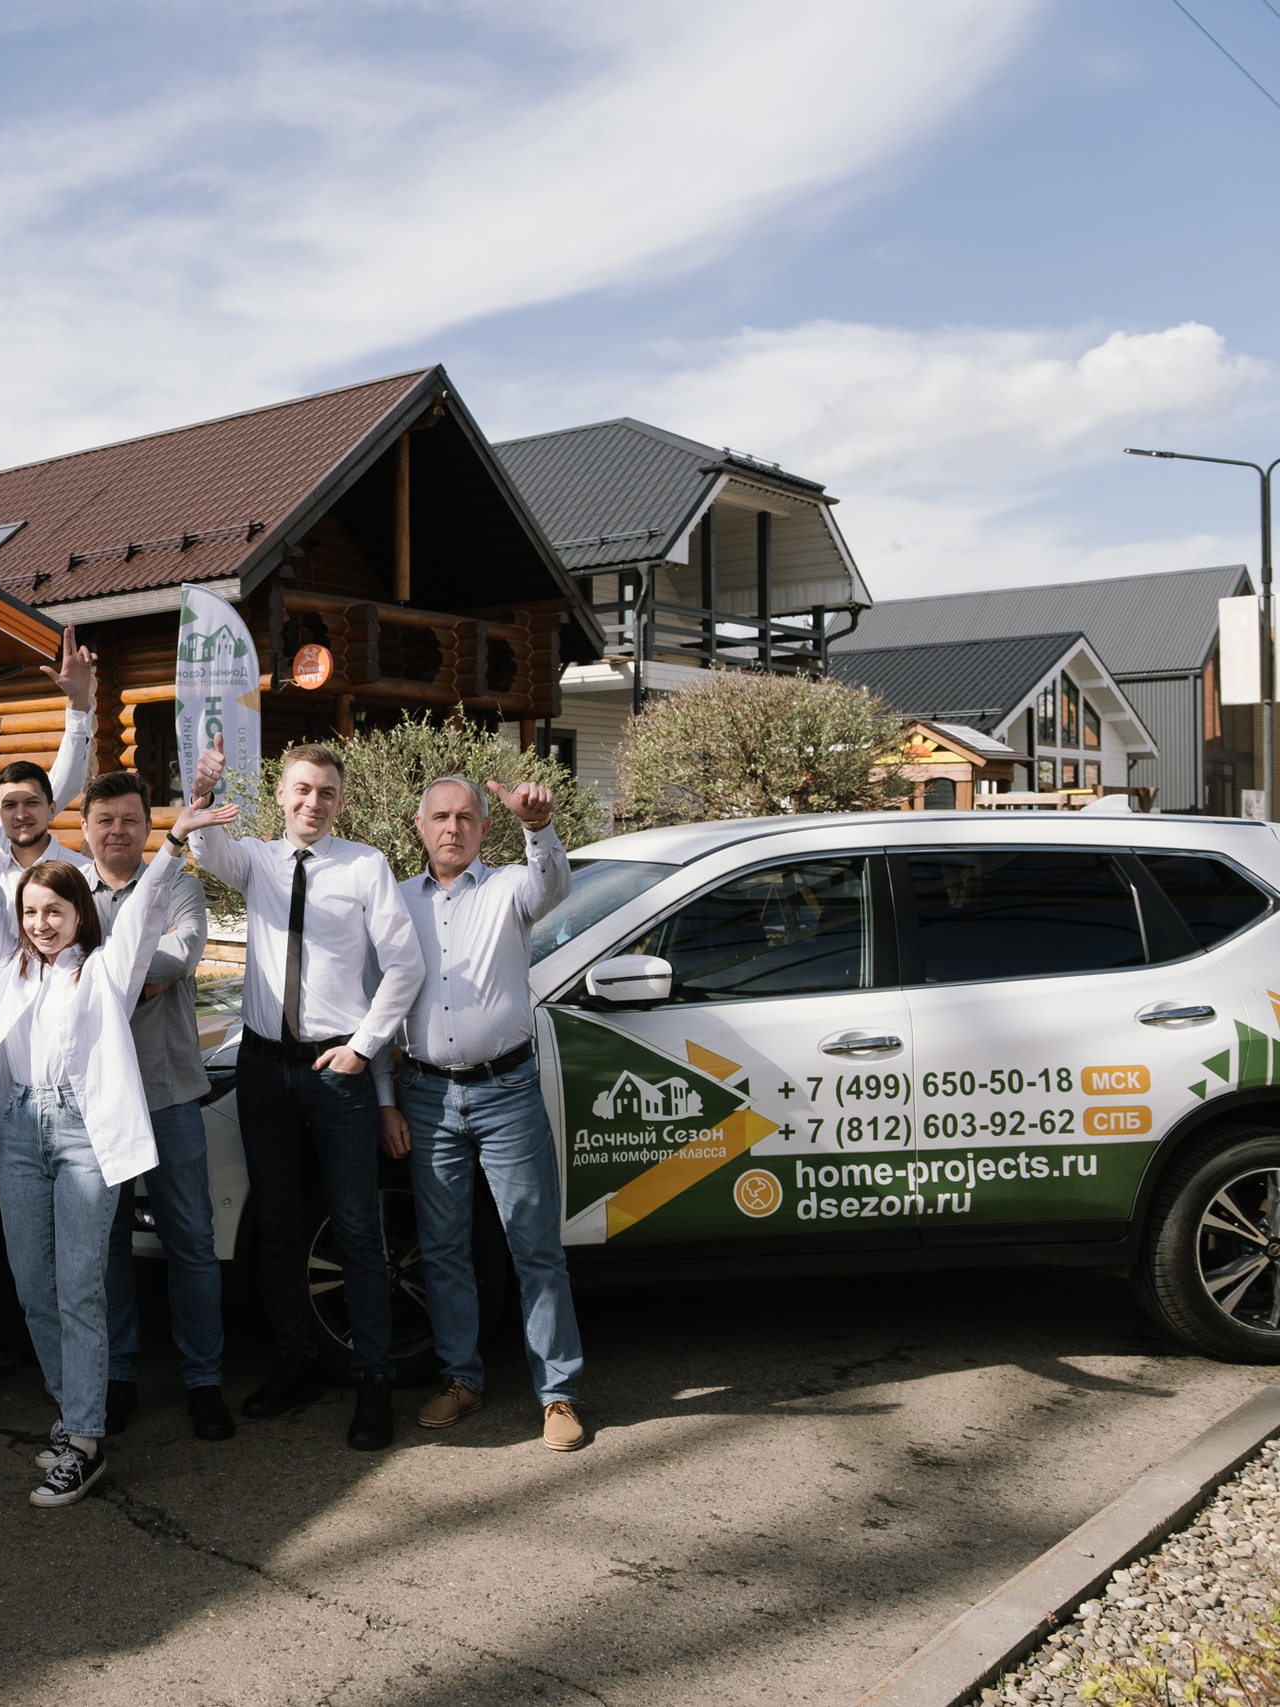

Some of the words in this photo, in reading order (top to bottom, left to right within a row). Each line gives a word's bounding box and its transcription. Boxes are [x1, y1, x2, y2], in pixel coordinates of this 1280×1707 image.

[778, 1081, 795, 1099] +
[807, 1077, 823, 1101] 7
[835, 1073, 911, 1108] (499)
[922, 1067, 1073, 1097] 650-50-18
[1091, 1071, 1141, 1090] МСК
[778, 1123, 796, 1141] +
[807, 1118, 824, 1143] 7
[836, 1114, 911, 1149] (812)
[923, 1109, 1075, 1139] 603-92-62
[1093, 1112, 1142, 1131] СПБ
[574, 1126, 657, 1151] Дачный
[662, 1125, 724, 1144] Сезон
[573, 1152, 609, 1167] дома
[612, 1147, 727, 1164] комфорт-класса
[795, 1151, 1098, 1192] home-projects.ru
[796, 1191, 972, 1220] dsezon.ru
